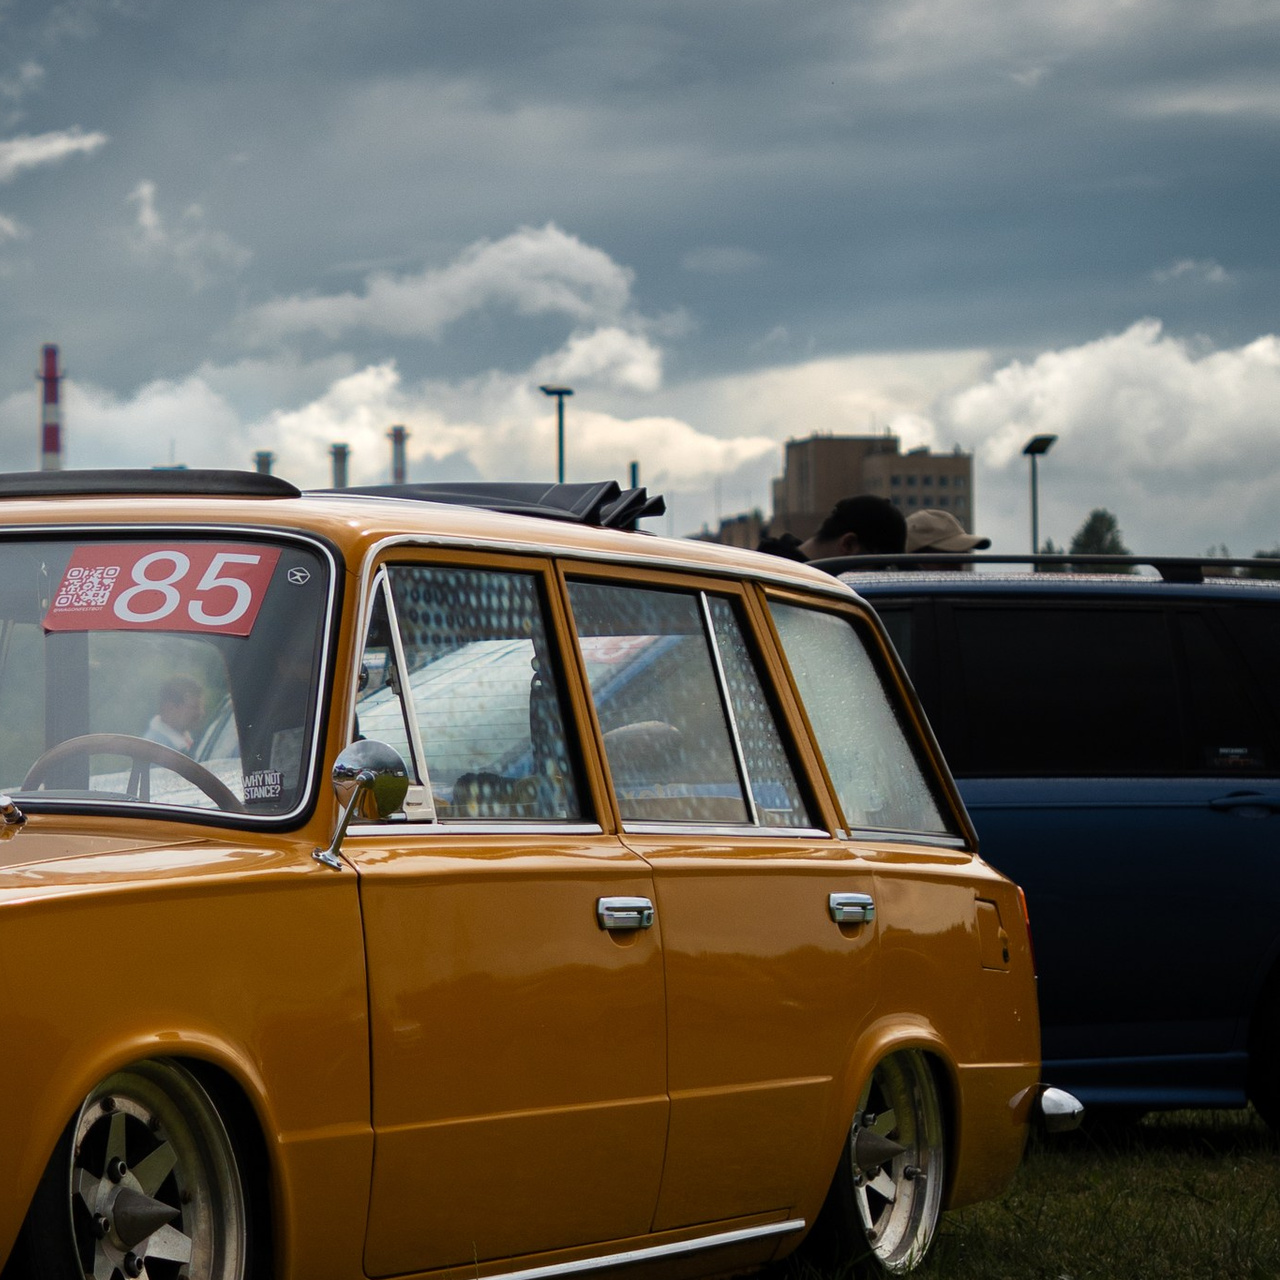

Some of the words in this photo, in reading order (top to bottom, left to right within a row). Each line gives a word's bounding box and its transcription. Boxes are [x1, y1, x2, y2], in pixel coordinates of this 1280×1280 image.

[113, 550, 261, 626] 85
[241, 773, 264, 787] WHY
[264, 772, 281, 785] NOT
[244, 785, 281, 800] STANCE?
